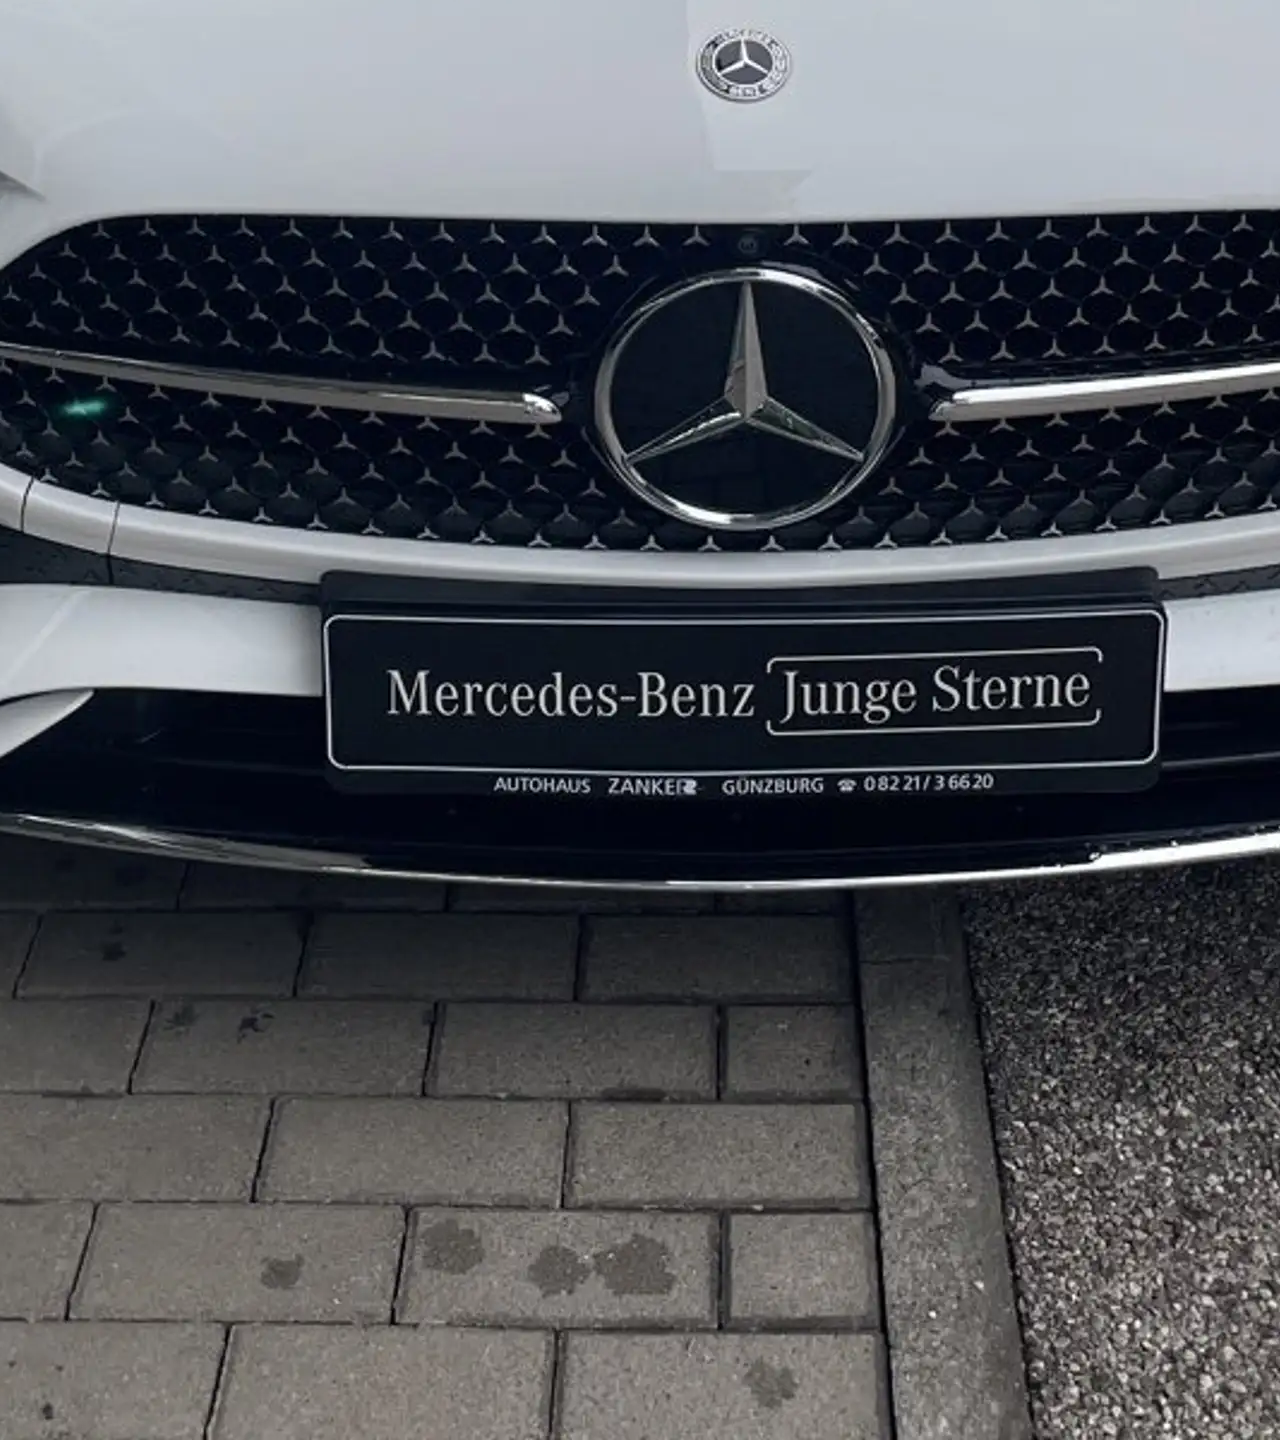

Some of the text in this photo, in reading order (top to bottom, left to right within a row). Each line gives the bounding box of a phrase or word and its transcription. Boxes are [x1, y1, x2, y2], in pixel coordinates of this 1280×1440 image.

[386, 664, 1092, 725] Mercedes-Benz Junge Sterne
[493, 776, 592, 795] AUTOHAUS
[722, 776, 825, 796] GÜNZBURG
